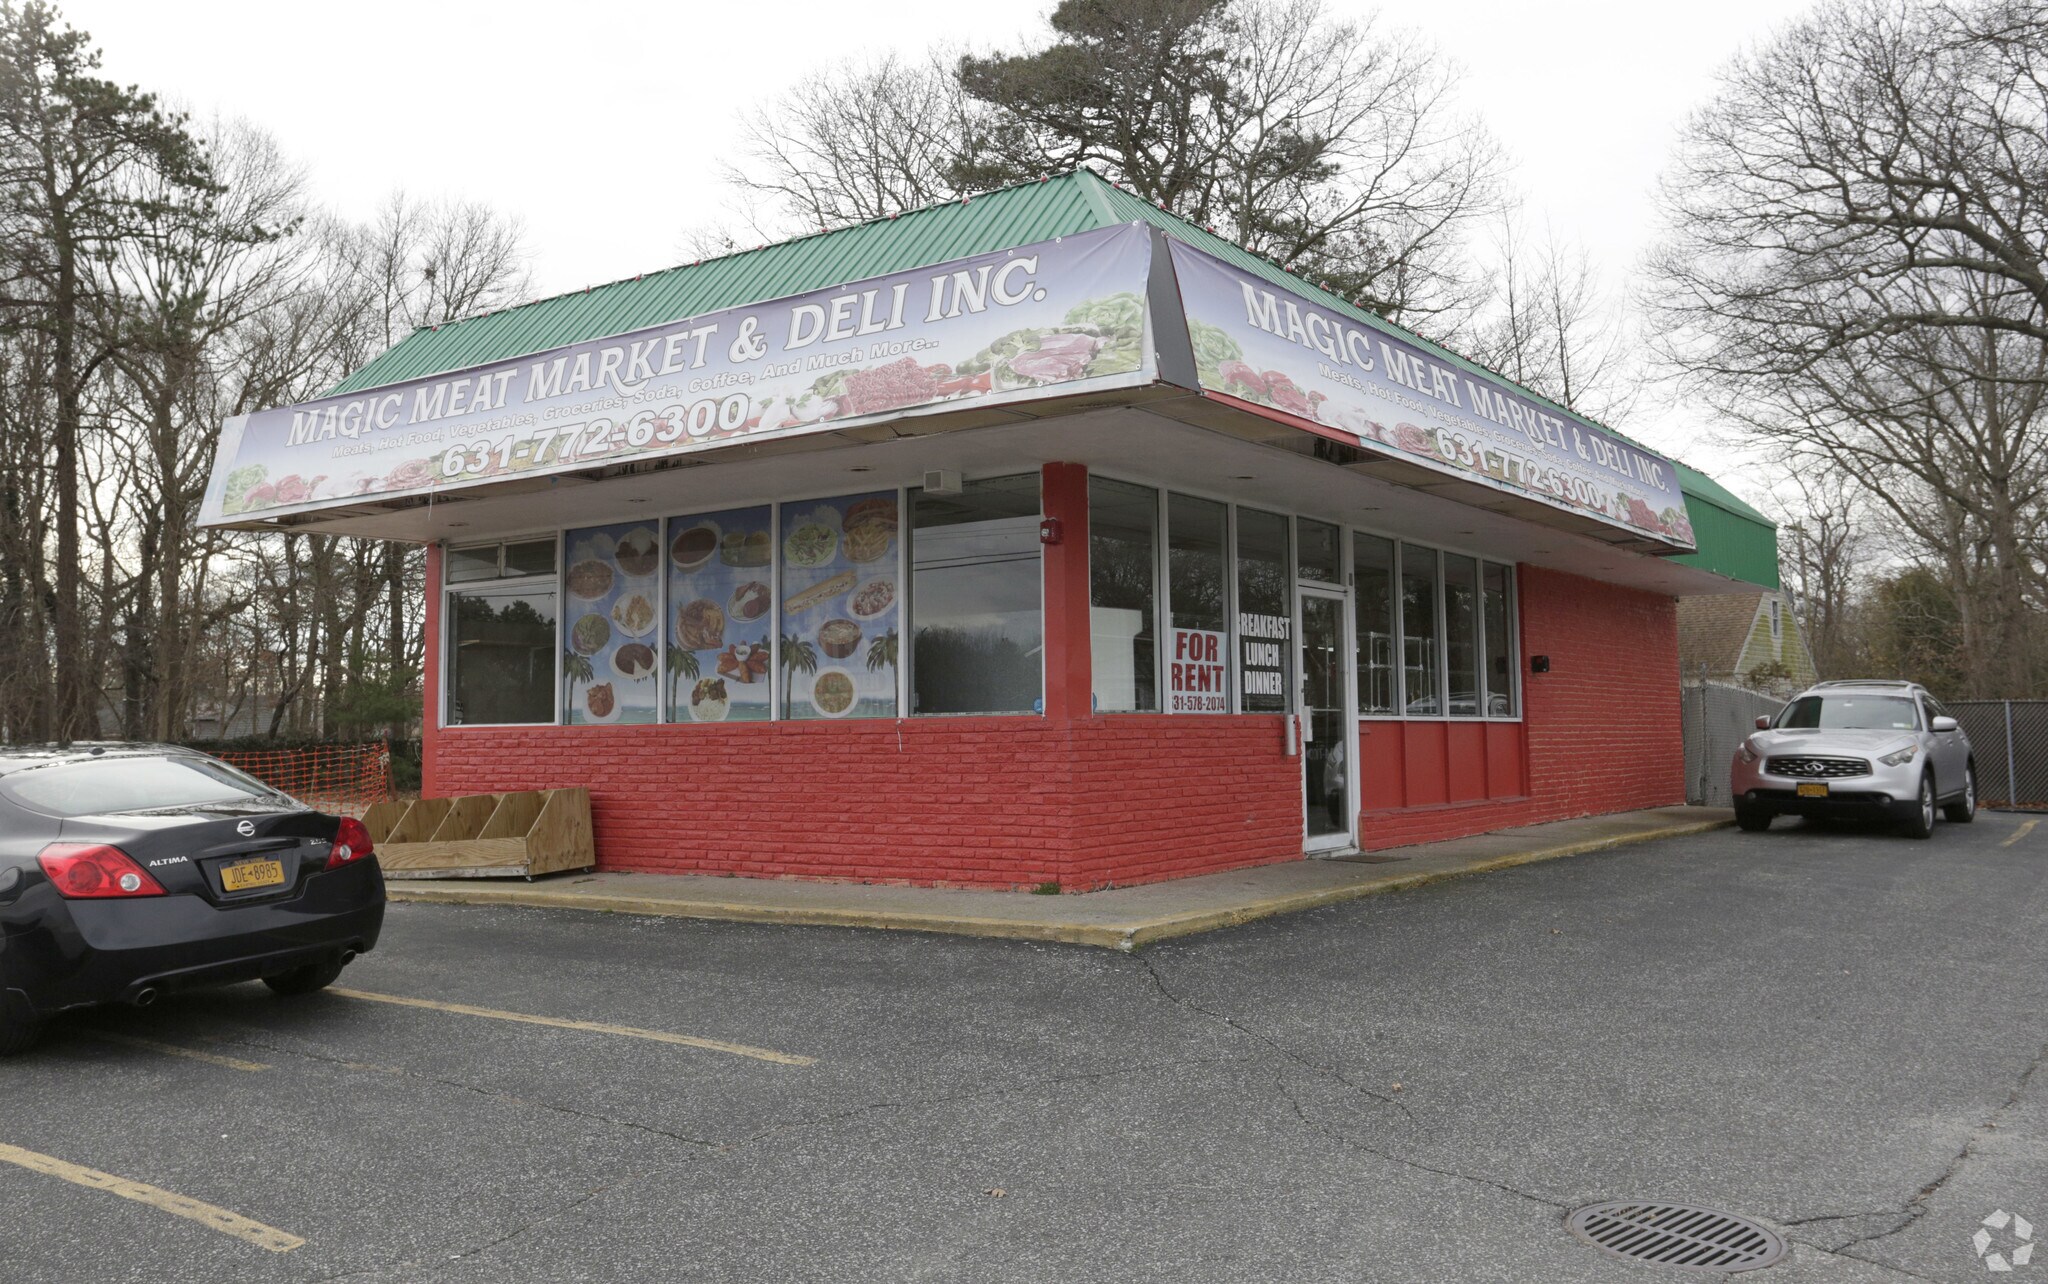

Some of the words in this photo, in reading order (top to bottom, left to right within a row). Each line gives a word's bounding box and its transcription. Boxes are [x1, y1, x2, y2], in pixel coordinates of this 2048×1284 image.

[285, 392, 404, 447] MAGIC
[407, 368, 518, 425] MEAT
[522, 323, 718, 403] MARKET
[728, 315, 768, 363] &
[783, 282, 910, 351] DELI
[924, 254, 1047, 323] INC.
[332, 442, 374, 459] Meats,
[378, 437, 403, 451] Hot
[406, 428, 445, 447] Food,
[450, 413, 538, 438] Vegetables,
[542, 397, 629, 421] Groceries,
[633, 383, 682, 404] Soda,
[688, 371, 756, 394] Coffee,
[760, 362, 801, 380] And
[806, 349, 864, 373] Much
[869, 336, 940, 360] More..
[1239, 280, 1374, 372] MAGIC
[1378, 341, 1463, 408] MEAT
[1465, 379, 1569, 451] MARKET
[1572, 427, 1592, 462] &
[1588, 434, 1634, 479] DELI
[1633, 453, 1670, 493] INC.
[1318, 362, 1366, 395] Meats,
[1367, 381, 1393, 402] Hot
[1395, 391, 1429, 417] Food,
[1428, 404, 1493, 440] Vegetables,
[442, 392, 751, 477] 631-772-6300
[1436, 427, 1601, 509] 631-772-6300
[1176, 631, 1218, 662] FOR
[1246, 642, 1279, 667] LUNCH
[1171, 663, 1224, 692] RENT
[1171, 695, 1225, 711] 31-578-2074
[1244, 670, 1282, 695] DINNER
[149, 855, 188, 867] ALTIMA
